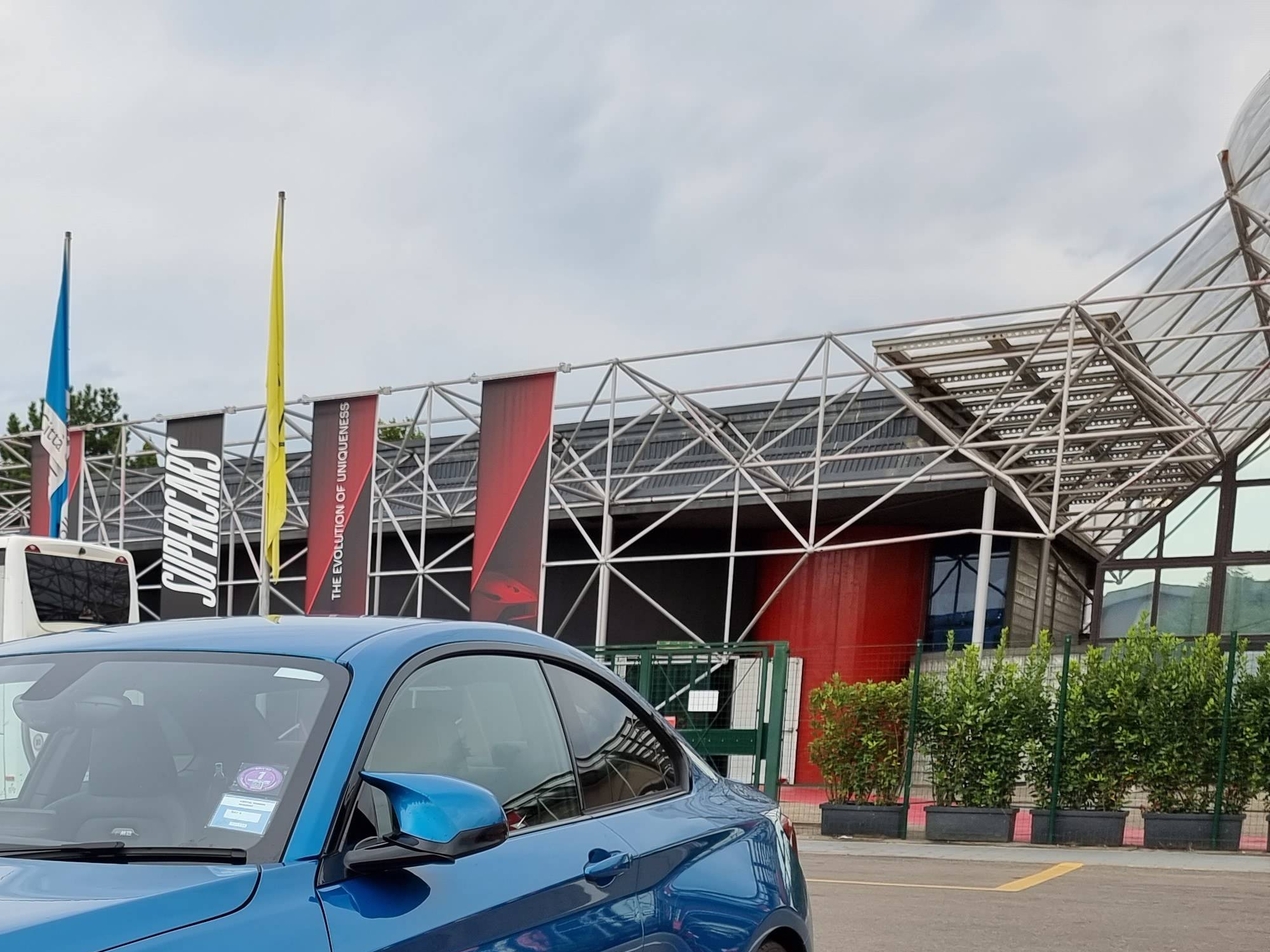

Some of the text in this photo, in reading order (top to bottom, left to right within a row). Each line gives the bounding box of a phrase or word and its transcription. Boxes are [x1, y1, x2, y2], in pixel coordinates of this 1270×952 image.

[161, 436, 222, 608] SUPERCARS
[331, 401, 350, 600] THE EVOLUTION OF UNIQUENESS
